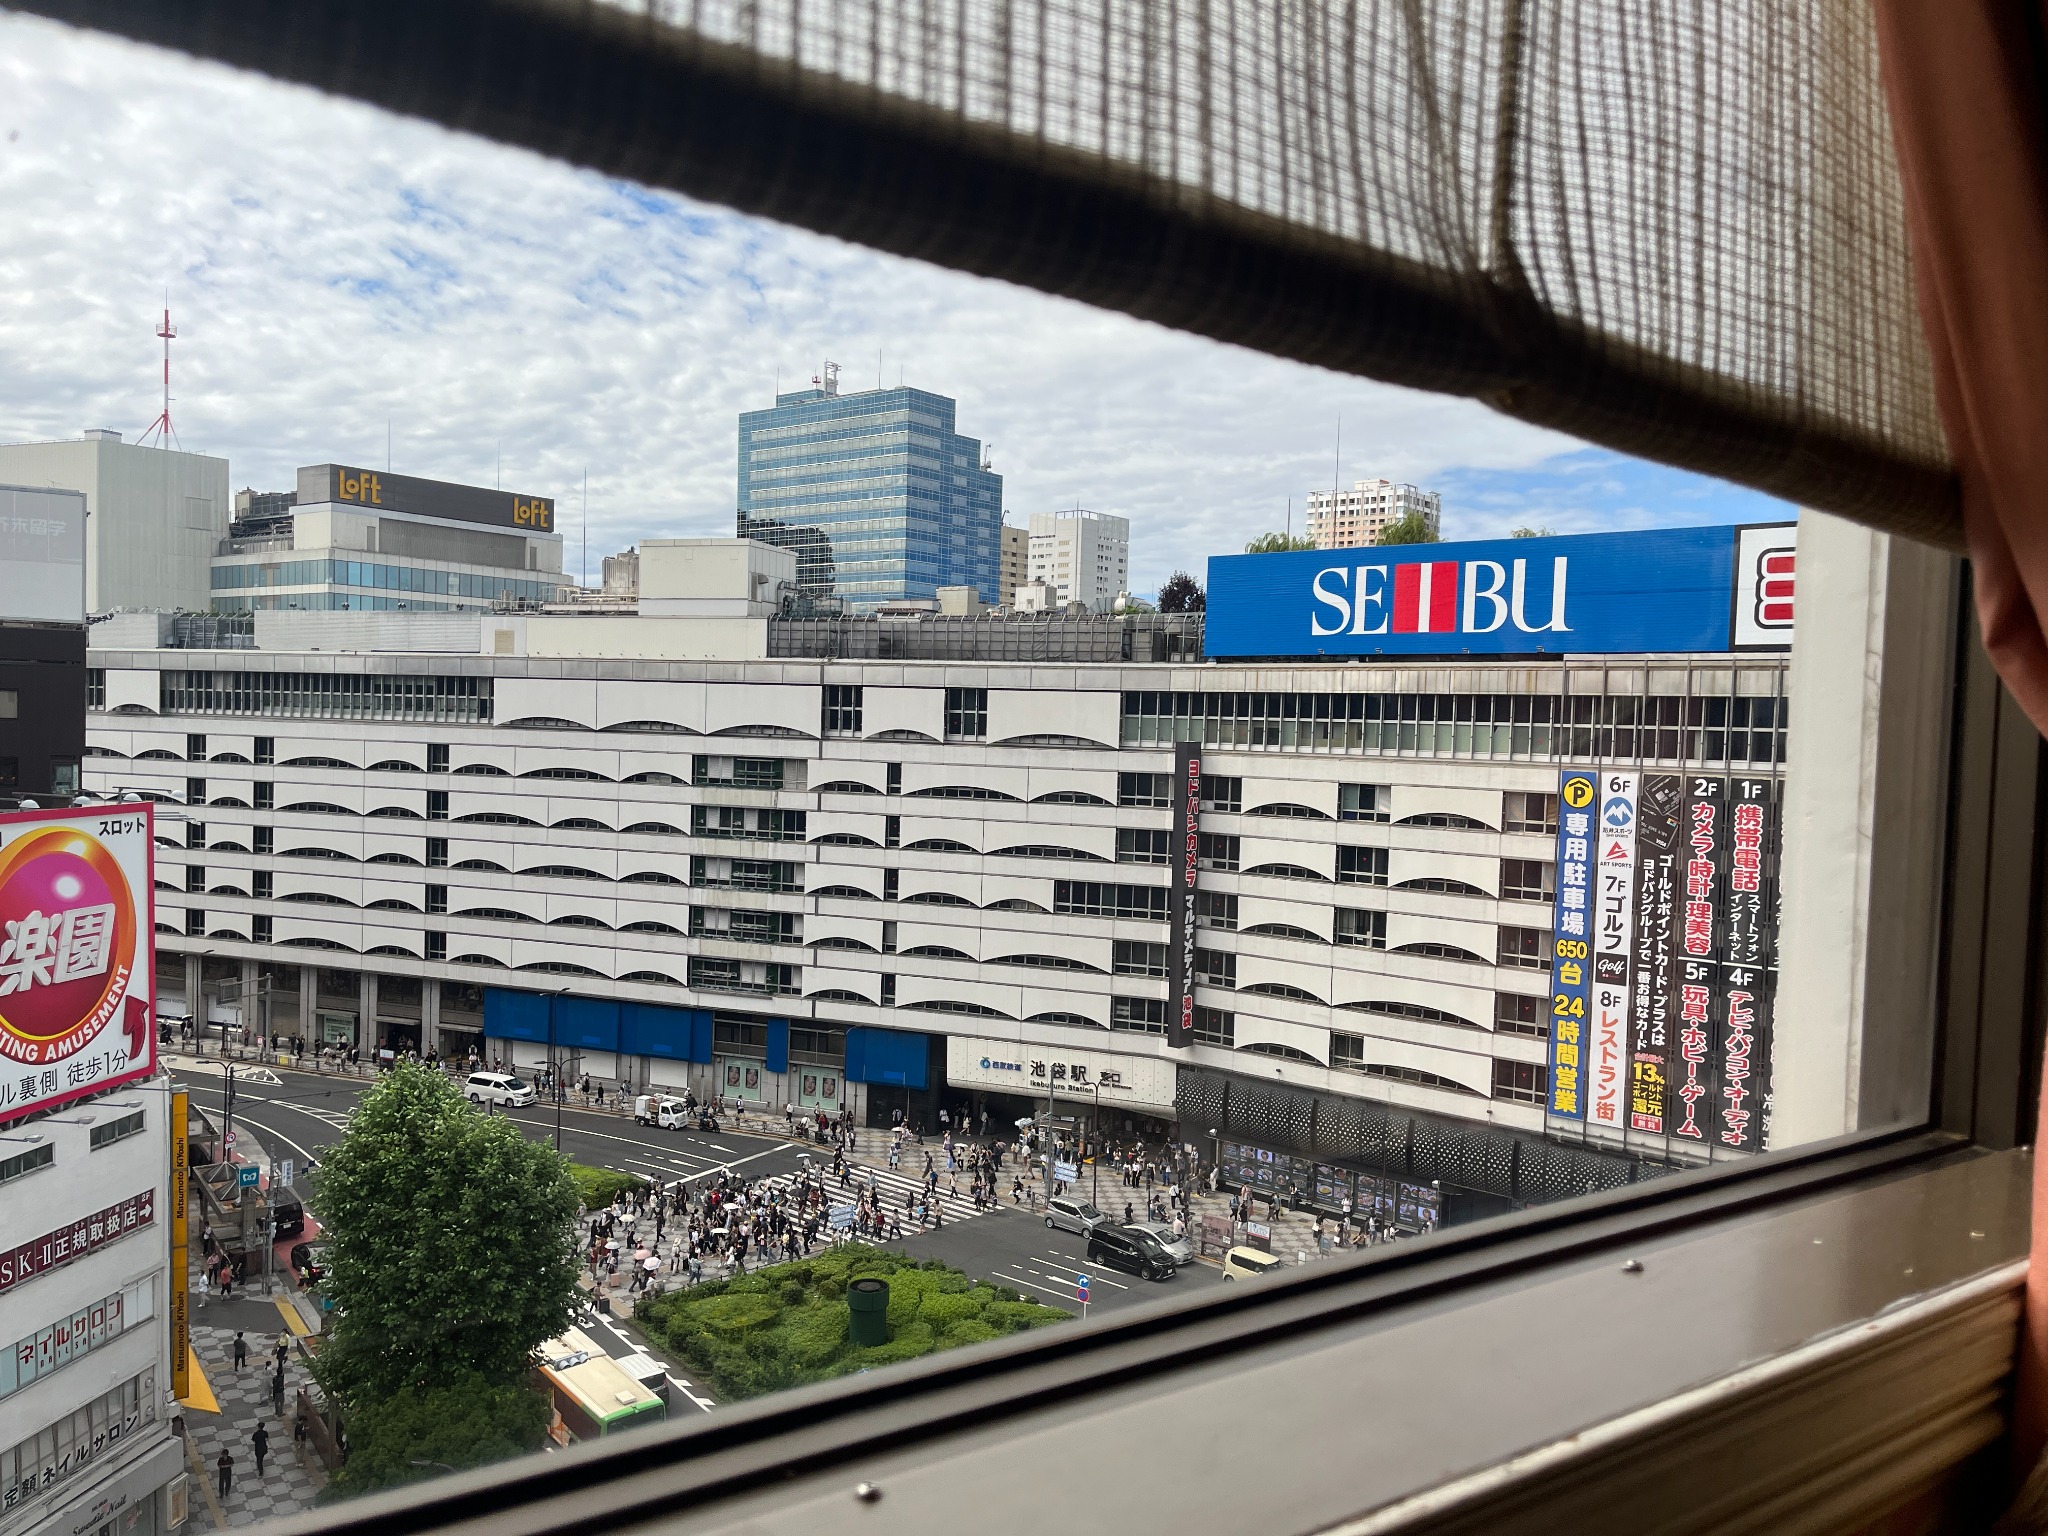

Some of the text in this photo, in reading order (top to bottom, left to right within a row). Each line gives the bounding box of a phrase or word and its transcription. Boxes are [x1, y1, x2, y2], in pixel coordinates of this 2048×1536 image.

[1311, 556, 1574, 636] SEIBU
[1609, 776, 1631, 792] 6F
[1693, 778, 1718, 797] 2F
[1741, 780, 1762, 799] 1F
[99, 817, 146, 837] スロット
[1185, 759, 1200, 887] ヨドバシカメラ
[1732, 803, 1763, 892] 携帯電話
[1561, 812, 1589, 936] 専用駐車場
[1605, 875, 1626, 892] 7F
[1684, 802, 1715, 956] カメラ・時計・理美容
[1603, 896, 1627, 950] ゴルフ
[1728, 893, 1744, 962] インターネット
[1745, 894, 1761, 963] スマートフォン
[0, 903, 116, 996] 楽園
[1597, 958, 1625, 975] Golf
[1651, 854, 1674, 1046] ゴールドポイントカード・プラスは
[1684, 962, 1708, 981] 5F
[1600, 991, 1621, 1008] 8F
[1729, 967, 1754, 986] 4F
[0, 965, 130, 1062] TING AMUSEMENT
[1030, 1060, 1087, 1083] 池袋駅
[1595, 1011, 1619, 1122] レストラン街
[1633, 1062, 1665, 1085] 13%
[1677, 984, 1709, 1139] 玩具・ホビー・ゲーム
[1721, 990, 1755, 1145] テレビ・パソコン・オーディオ
[1030, 1080, 1094, 1094] Ikebuuro Station
[1632, 1089, 1663, 1100] ポイント
[1632, 1098, 1662, 1116] 還元
[1633, 1081, 1663, 1093] ゴールド
[141, 1191, 151, 1202] 2F
[176, 1171, 185, 1220] Matsumoto
[55, 1206, 137, 1259] 正規取扱店
[19, 1299, 121, 1365] ネイルサロン
[177, 1324, 185, 1372] Matsumoto
